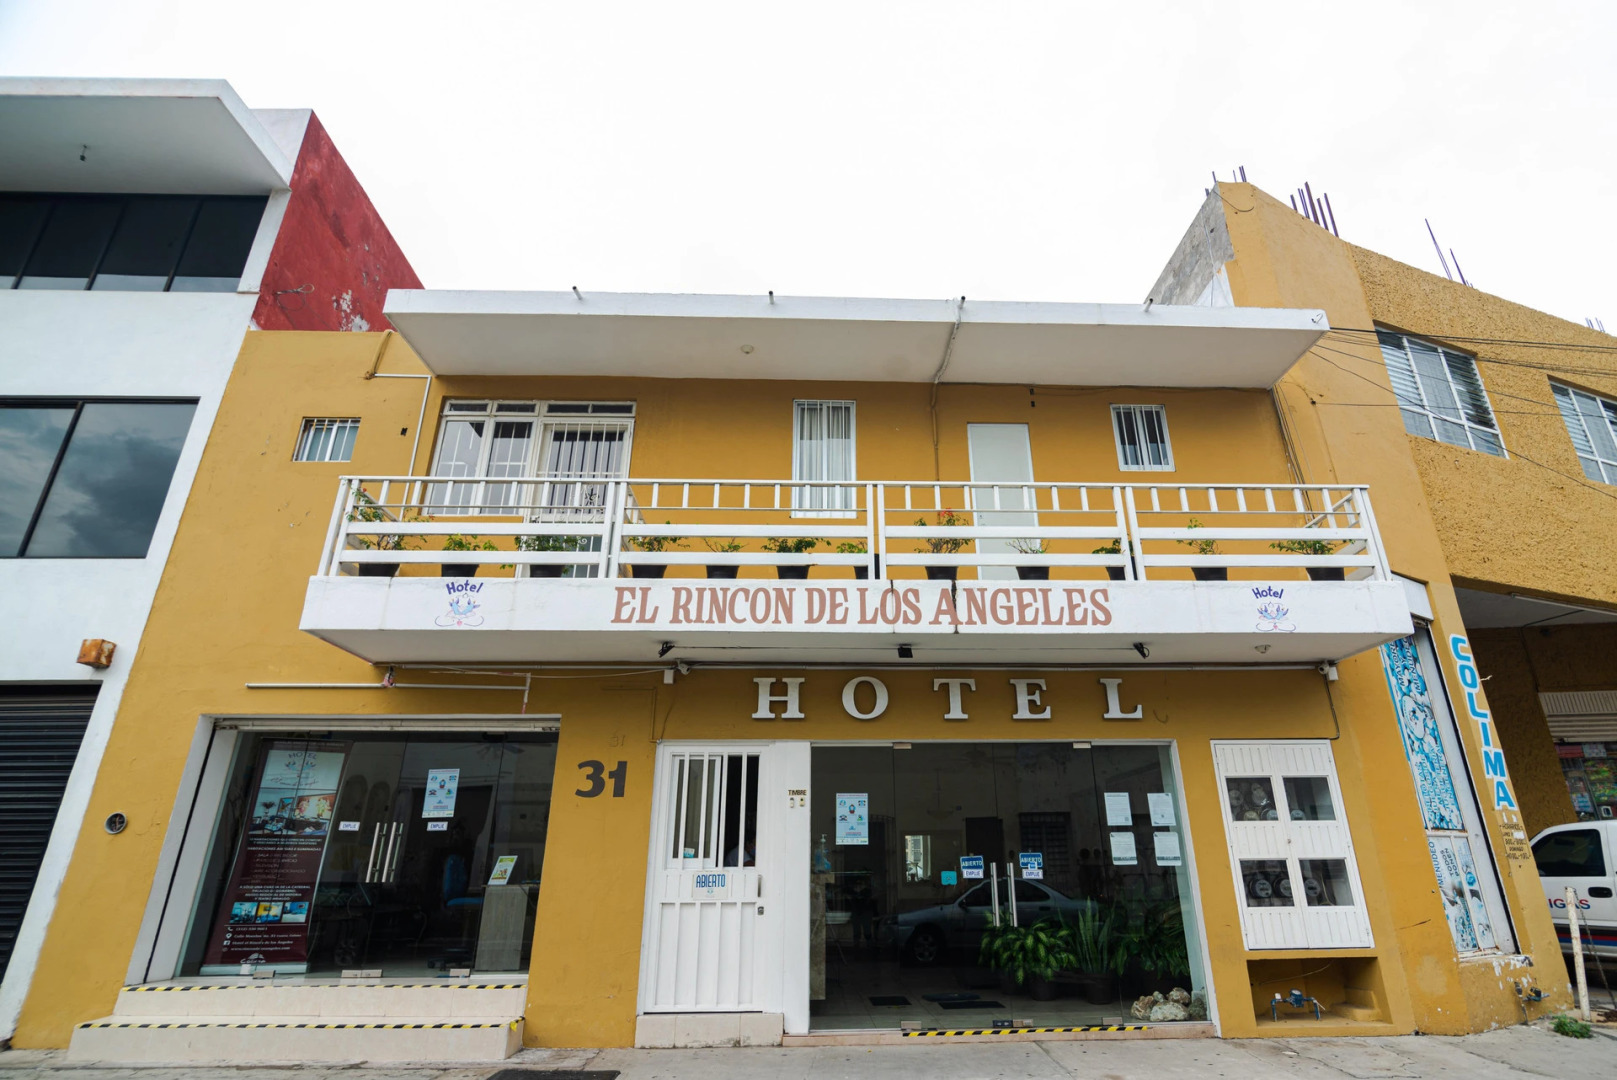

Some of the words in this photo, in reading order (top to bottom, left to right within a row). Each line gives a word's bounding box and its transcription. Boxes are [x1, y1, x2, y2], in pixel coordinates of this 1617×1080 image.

[446, 580, 484, 594] Hotel
[1252, 586, 1284, 599] Hotel
[611, 587, 659, 624] EL
[669, 587, 796, 624] RINCON
[804, 587, 849, 625] DE
[856, 588, 922, 625] LOS
[929, 588, 1112, 626] ANGELES
[751, 676, 1143, 720] HOTEL
[1450, 634, 1517, 810] COLIMA
[575, 760, 628, 798] 31
[1428, 841, 1445, 886] MENUDEO
[1440, 849, 1454, 877] TODOS
[1445, 848, 1460, 877] PONEN
[696, 874, 726, 888] ABIERTO
[1548, 898, 1590, 909] IGS
